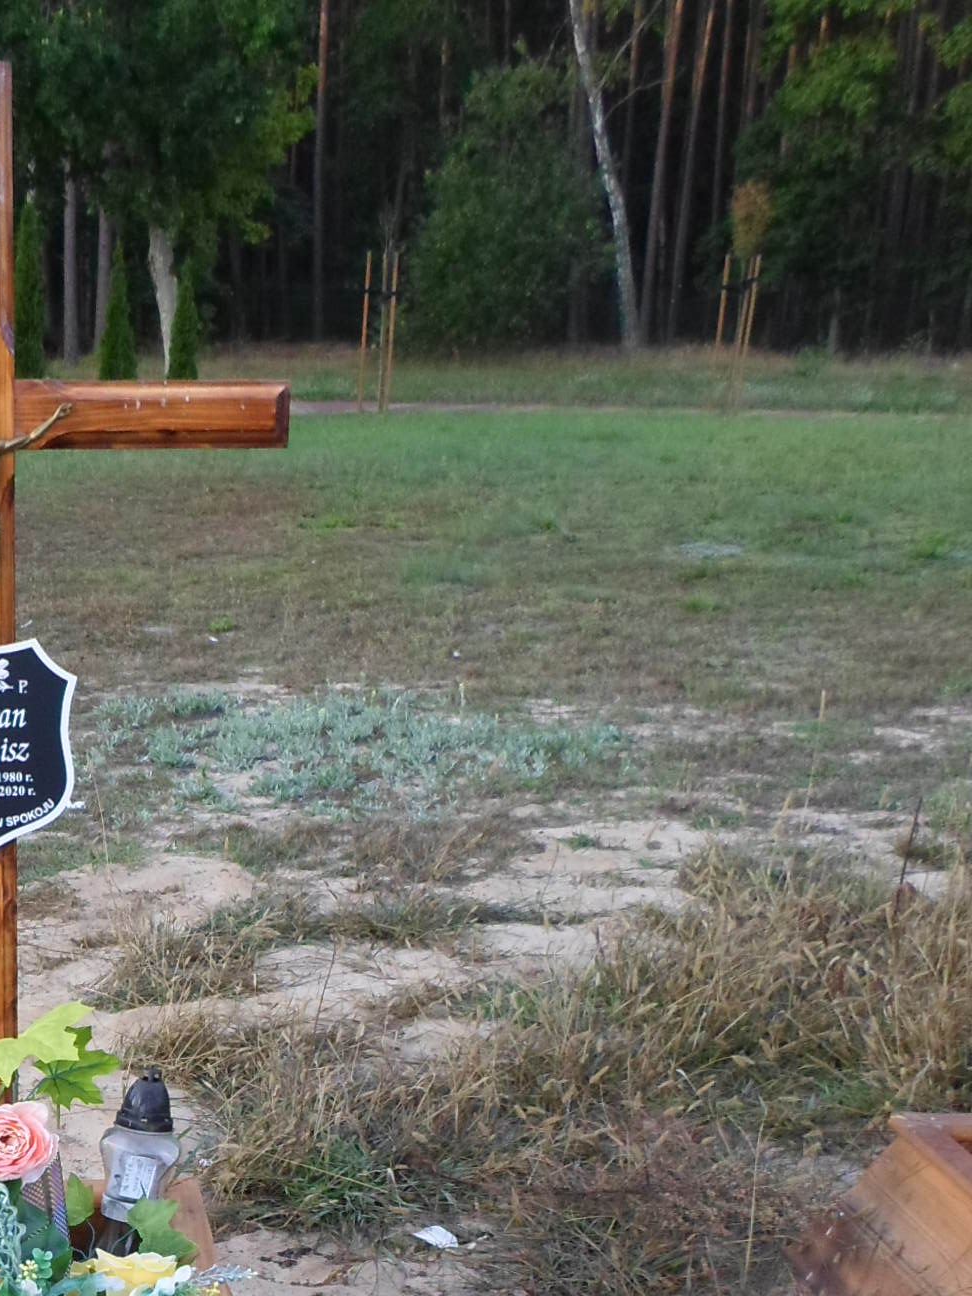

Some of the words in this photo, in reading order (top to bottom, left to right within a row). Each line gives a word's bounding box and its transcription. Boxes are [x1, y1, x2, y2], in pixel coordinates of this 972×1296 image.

[18, 679, 29, 694] P.
[25, 773, 34, 782] r.
[28, 787, 36, 796] r.
[5, 798, 55, 827] SPOKOJU
